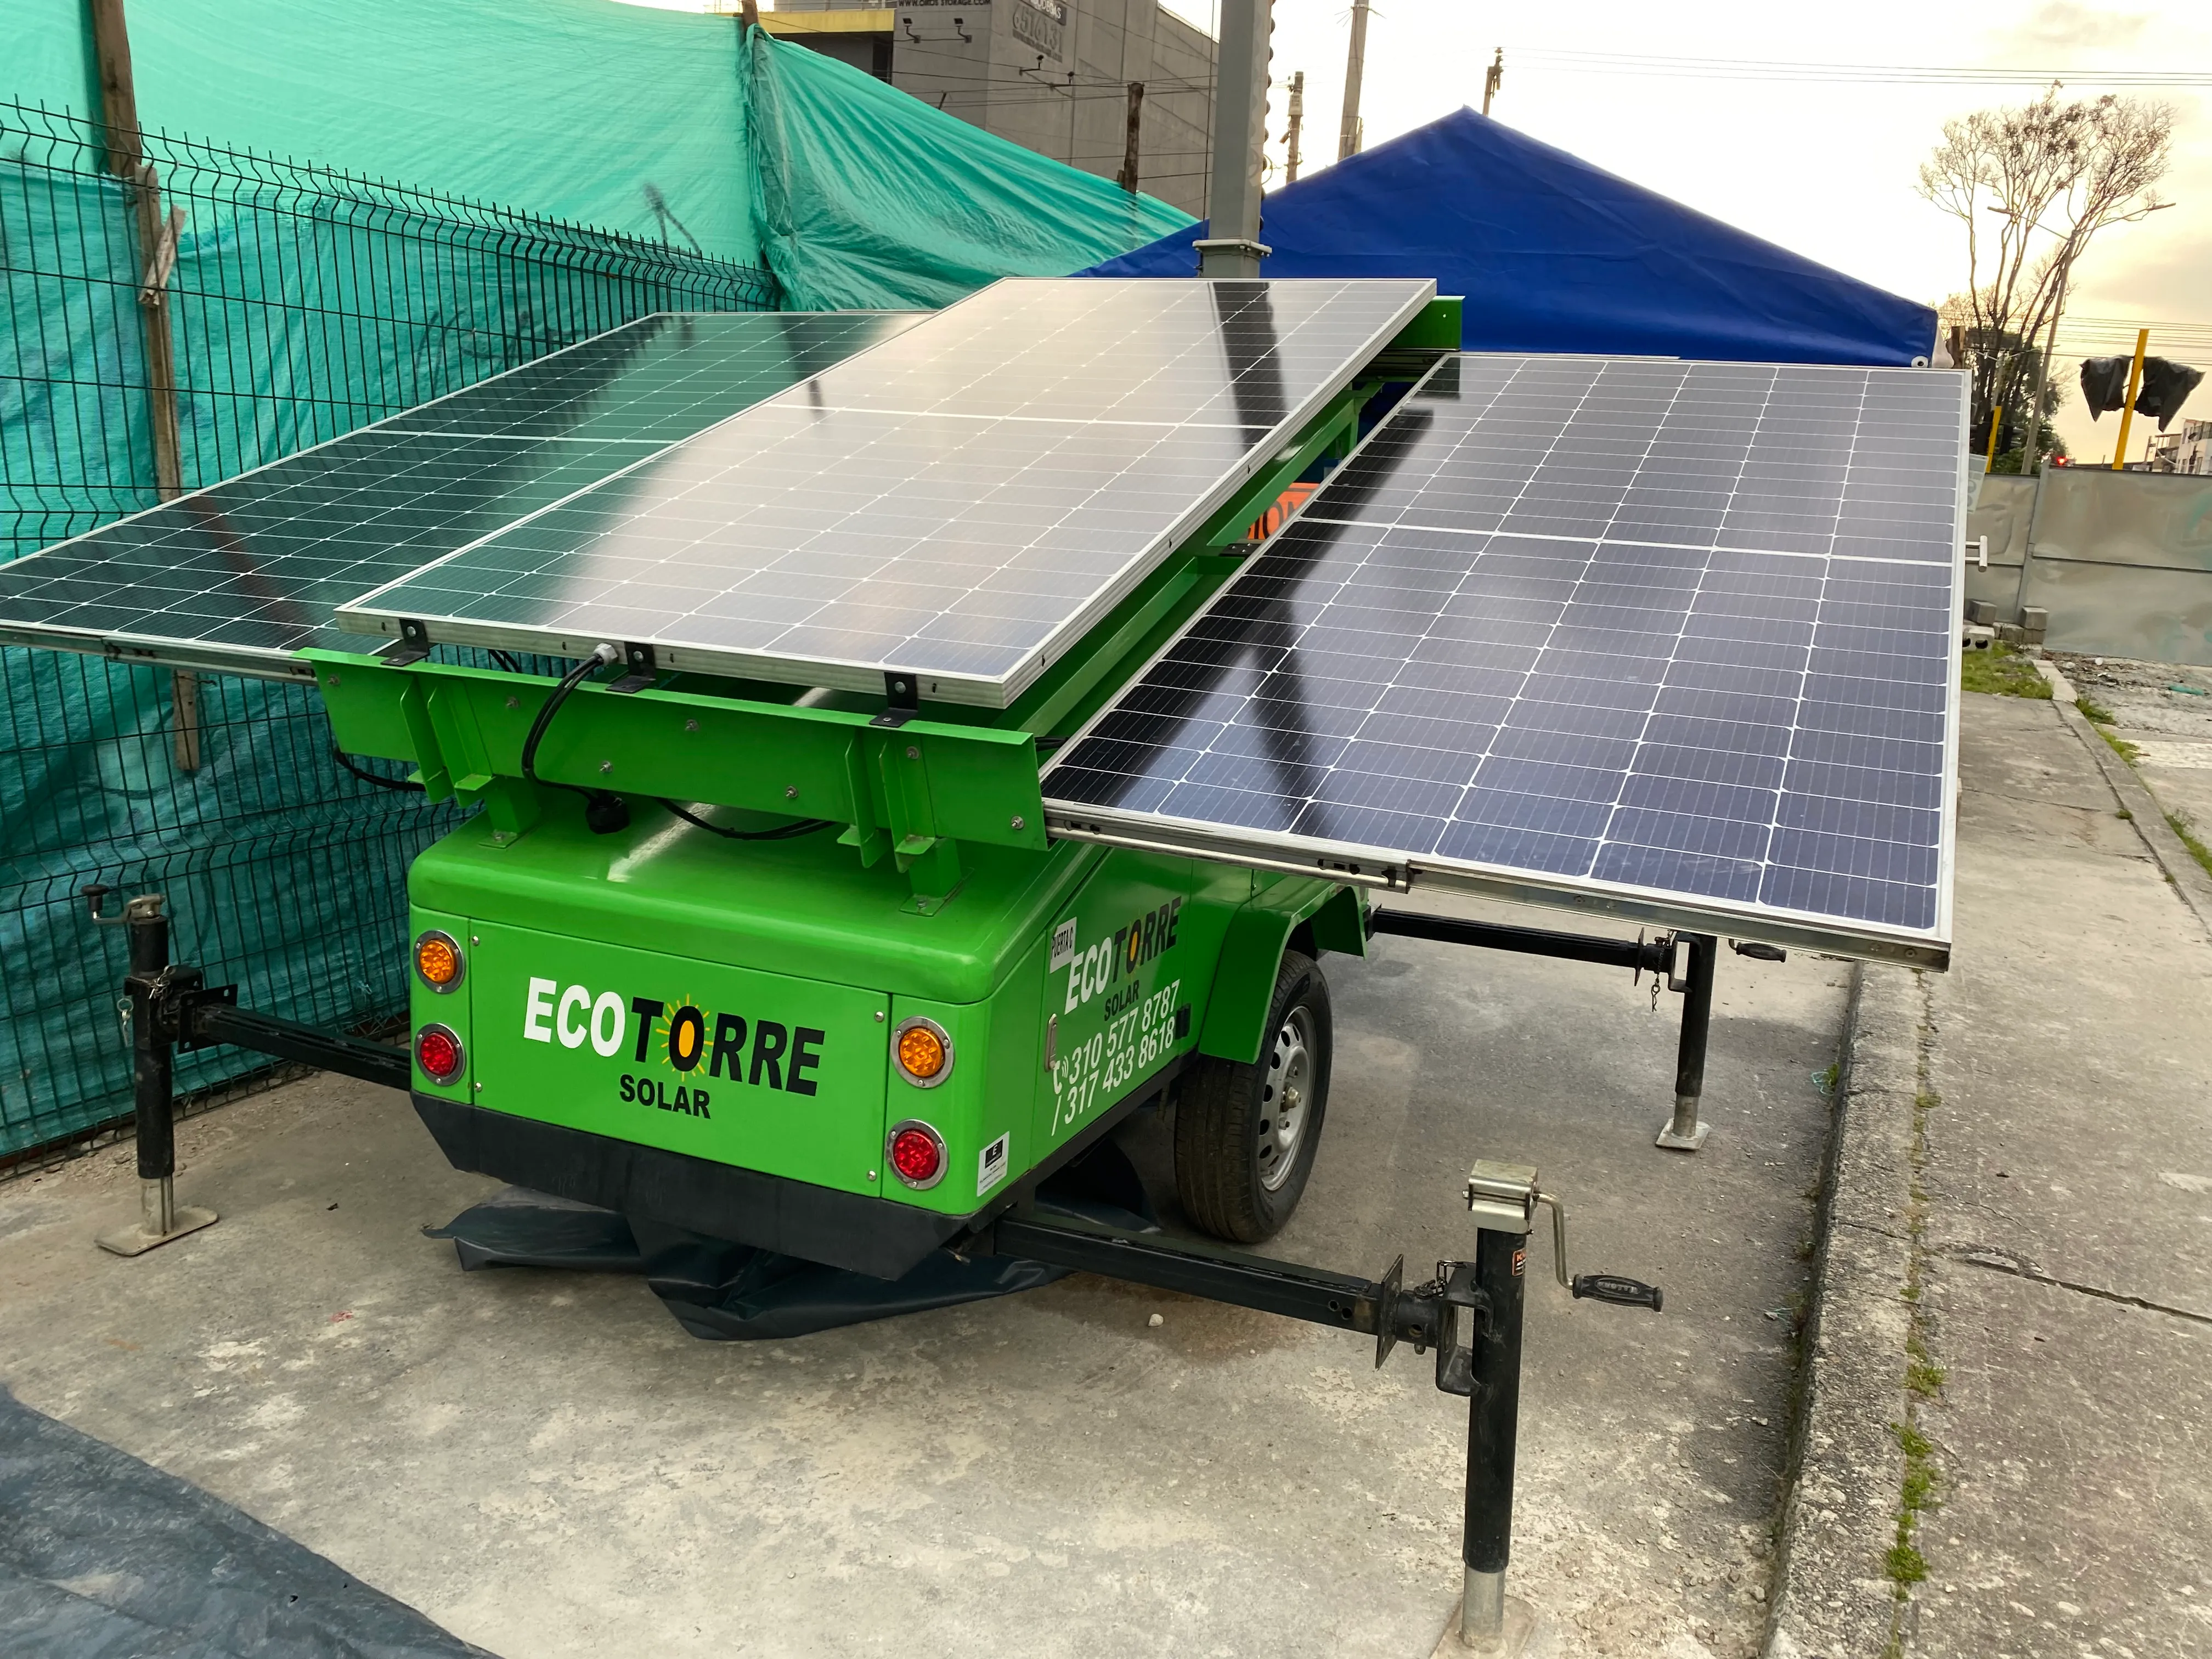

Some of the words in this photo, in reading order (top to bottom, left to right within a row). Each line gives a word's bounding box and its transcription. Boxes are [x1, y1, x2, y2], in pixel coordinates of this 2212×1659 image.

[1051, 929, 1069, 960] PUERTA
[1069, 926, 1073, 949] C
[1104, 980, 1139, 1022] SOLAR
[1069, 1032, 1103, 1084] 310
[1107, 1007, 1138, 1057] 577
[1142, 979, 1180, 1032] 8787
[1065, 1069, 1099, 1124] 317
[1103, 1045, 1135, 1093] 433
[1138, 1017, 1175, 1069] 8618
[619, 1074, 710, 1119] SOLAR
